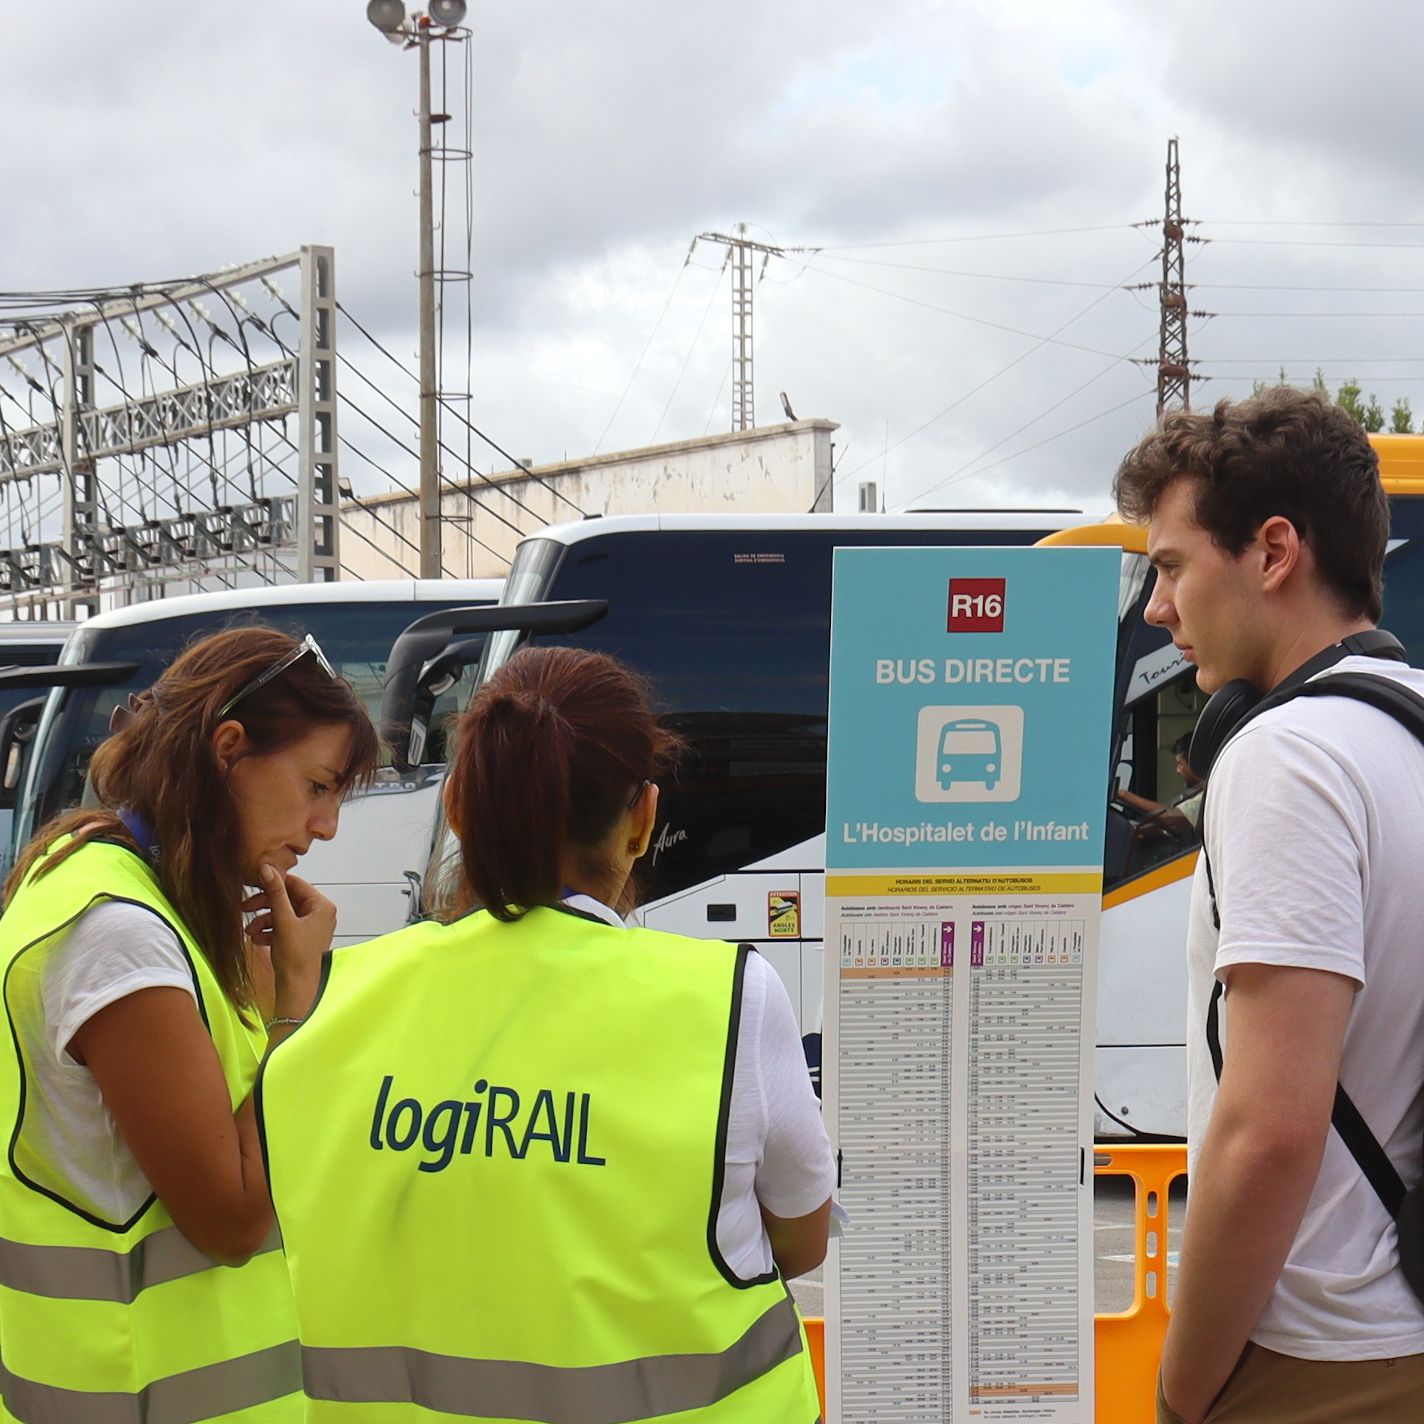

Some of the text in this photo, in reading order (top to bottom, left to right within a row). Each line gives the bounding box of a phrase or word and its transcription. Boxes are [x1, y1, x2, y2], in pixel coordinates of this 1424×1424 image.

[951, 594, 1001, 618] R16
[876, 658, 1070, 684] BUS DIRECTE
[1139, 652, 1185, 684] Touri
[653, 822, 688, 866] Aura
[843, 822, 974, 847] L'Hospitalet
[980, 822, 1008, 842] de
[370, 1075, 606, 1173] logiRAIL
